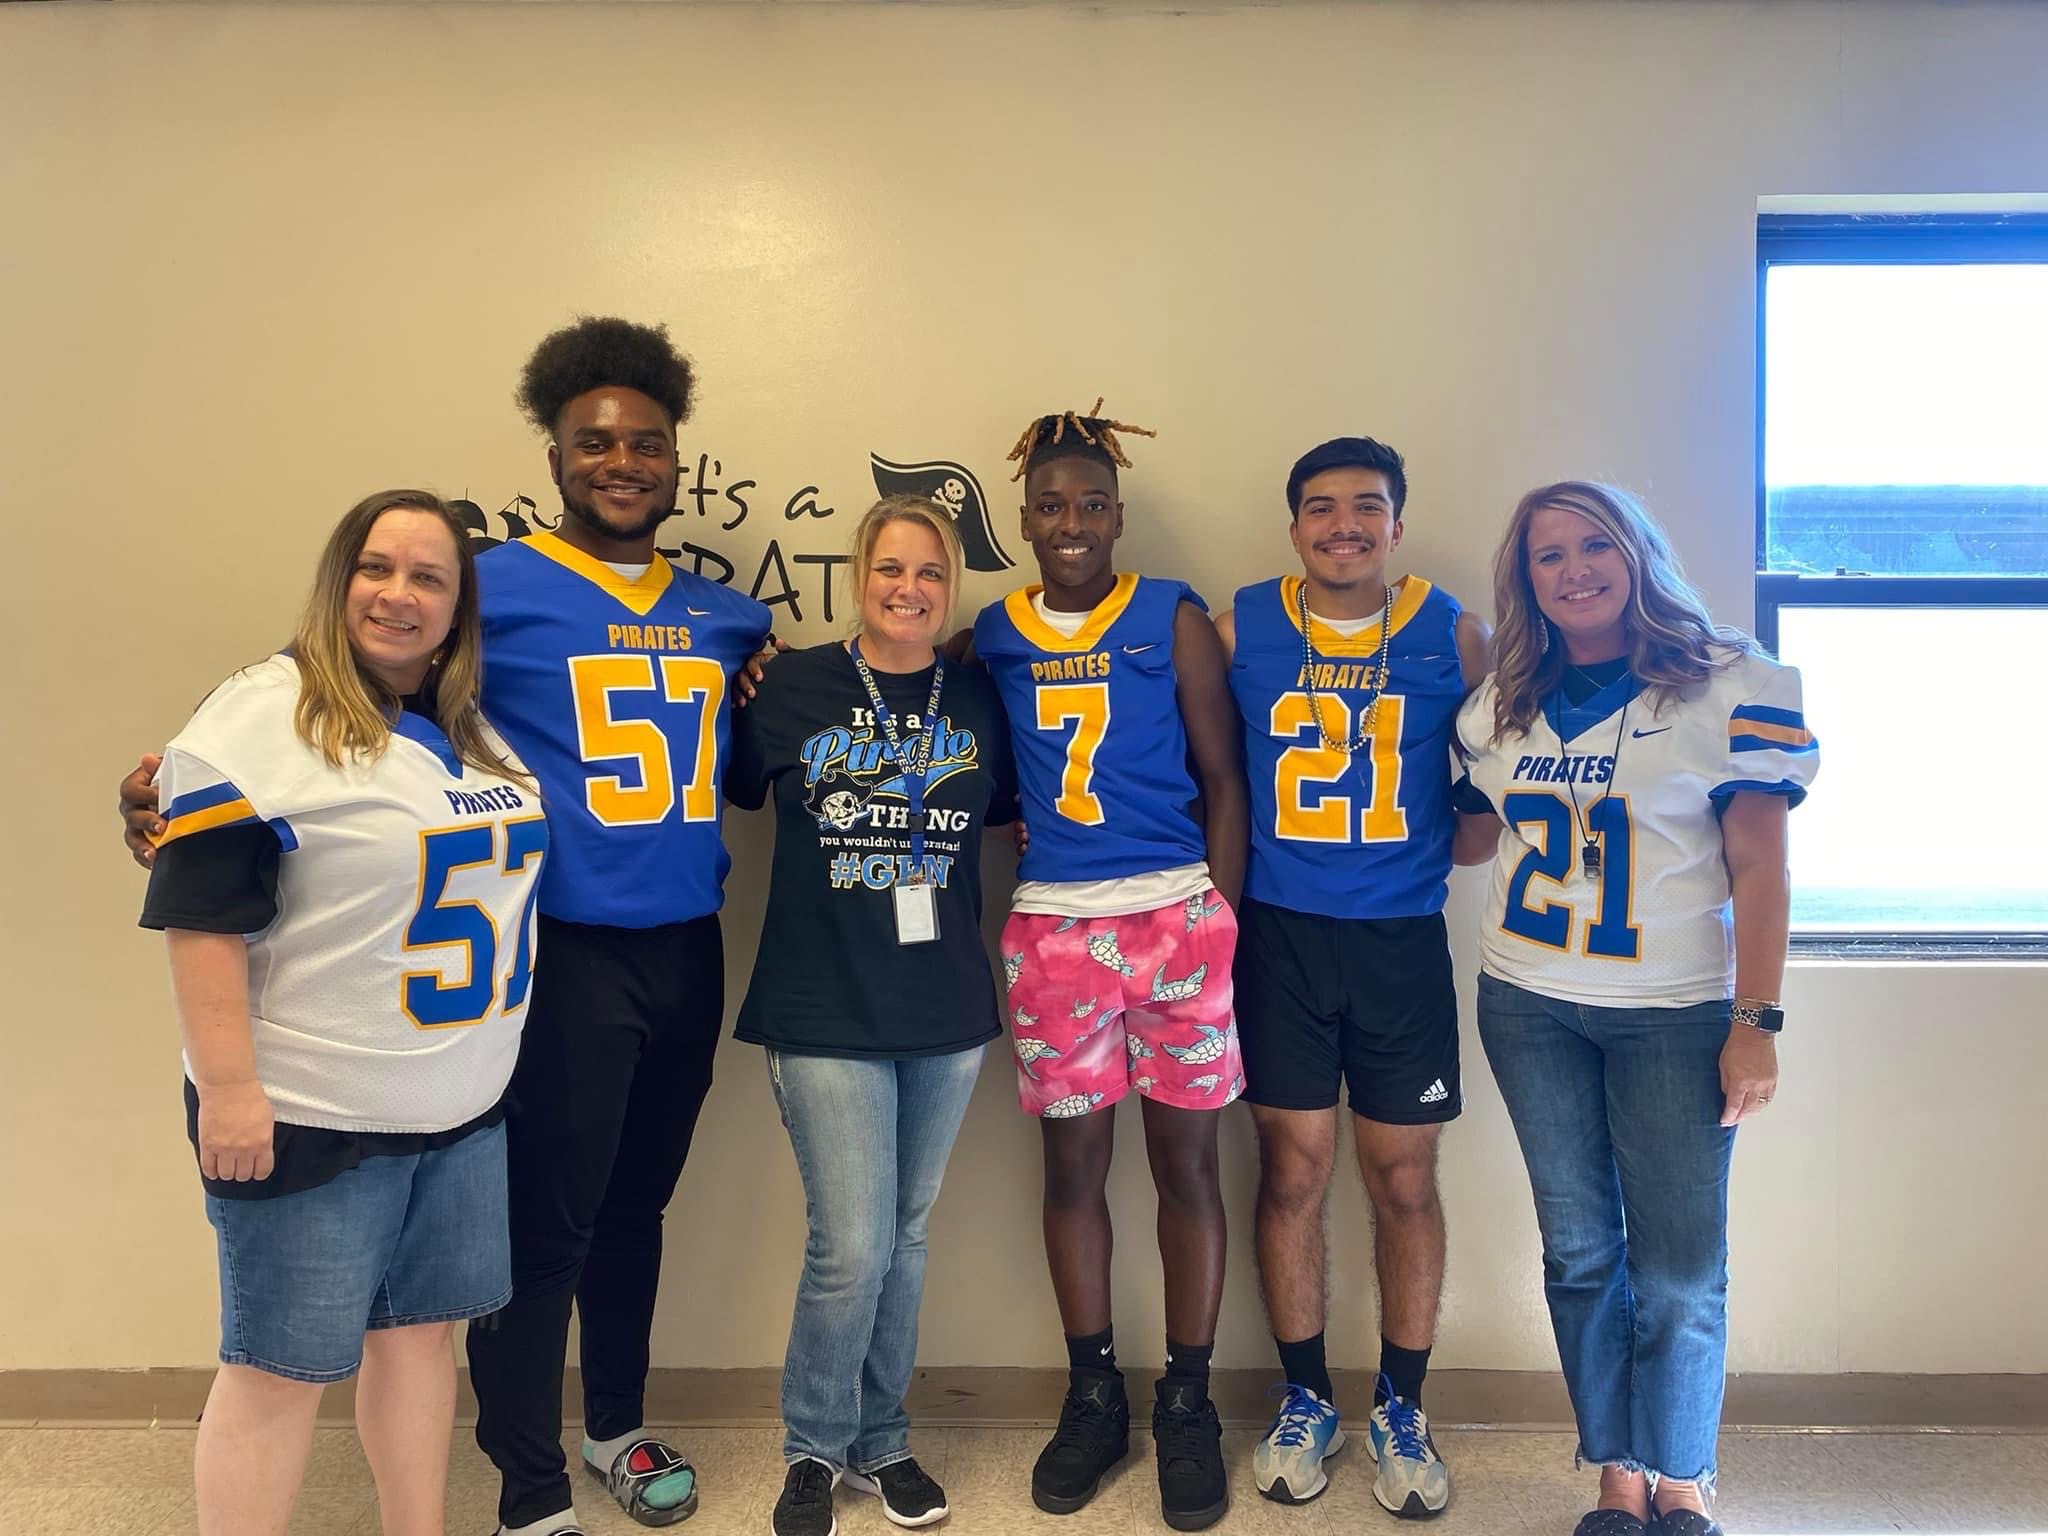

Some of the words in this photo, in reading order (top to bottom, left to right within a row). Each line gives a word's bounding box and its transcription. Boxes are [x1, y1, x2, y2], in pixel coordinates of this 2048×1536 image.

[672, 454, 756, 531] t's
[785, 486, 834, 520] a
[607, 624, 692, 650] PIRATES
[1031, 652, 1111, 682] PIRATES
[567, 654, 726, 827] 57
[856, 659, 885, 713] GOSNELL
[882, 719, 911, 774] PIRATES
[906, 713, 923, 729] a
[915, 723, 934, 777] GOSNELL
[927, 666, 944, 717] PIRATES
[1035, 682, 1111, 826] 7
[444, 784, 523, 815] PIRATES
[1270, 691, 1409, 843] 21
[1512, 755, 1616, 784] PIRATES
[819, 836, 841, 847] you
[843, 836, 897, 849] wouldn't
[867, 803, 970, 831] THNG
[1498, 788, 1643, 963] 21
[400, 814, 549, 1030] 57
